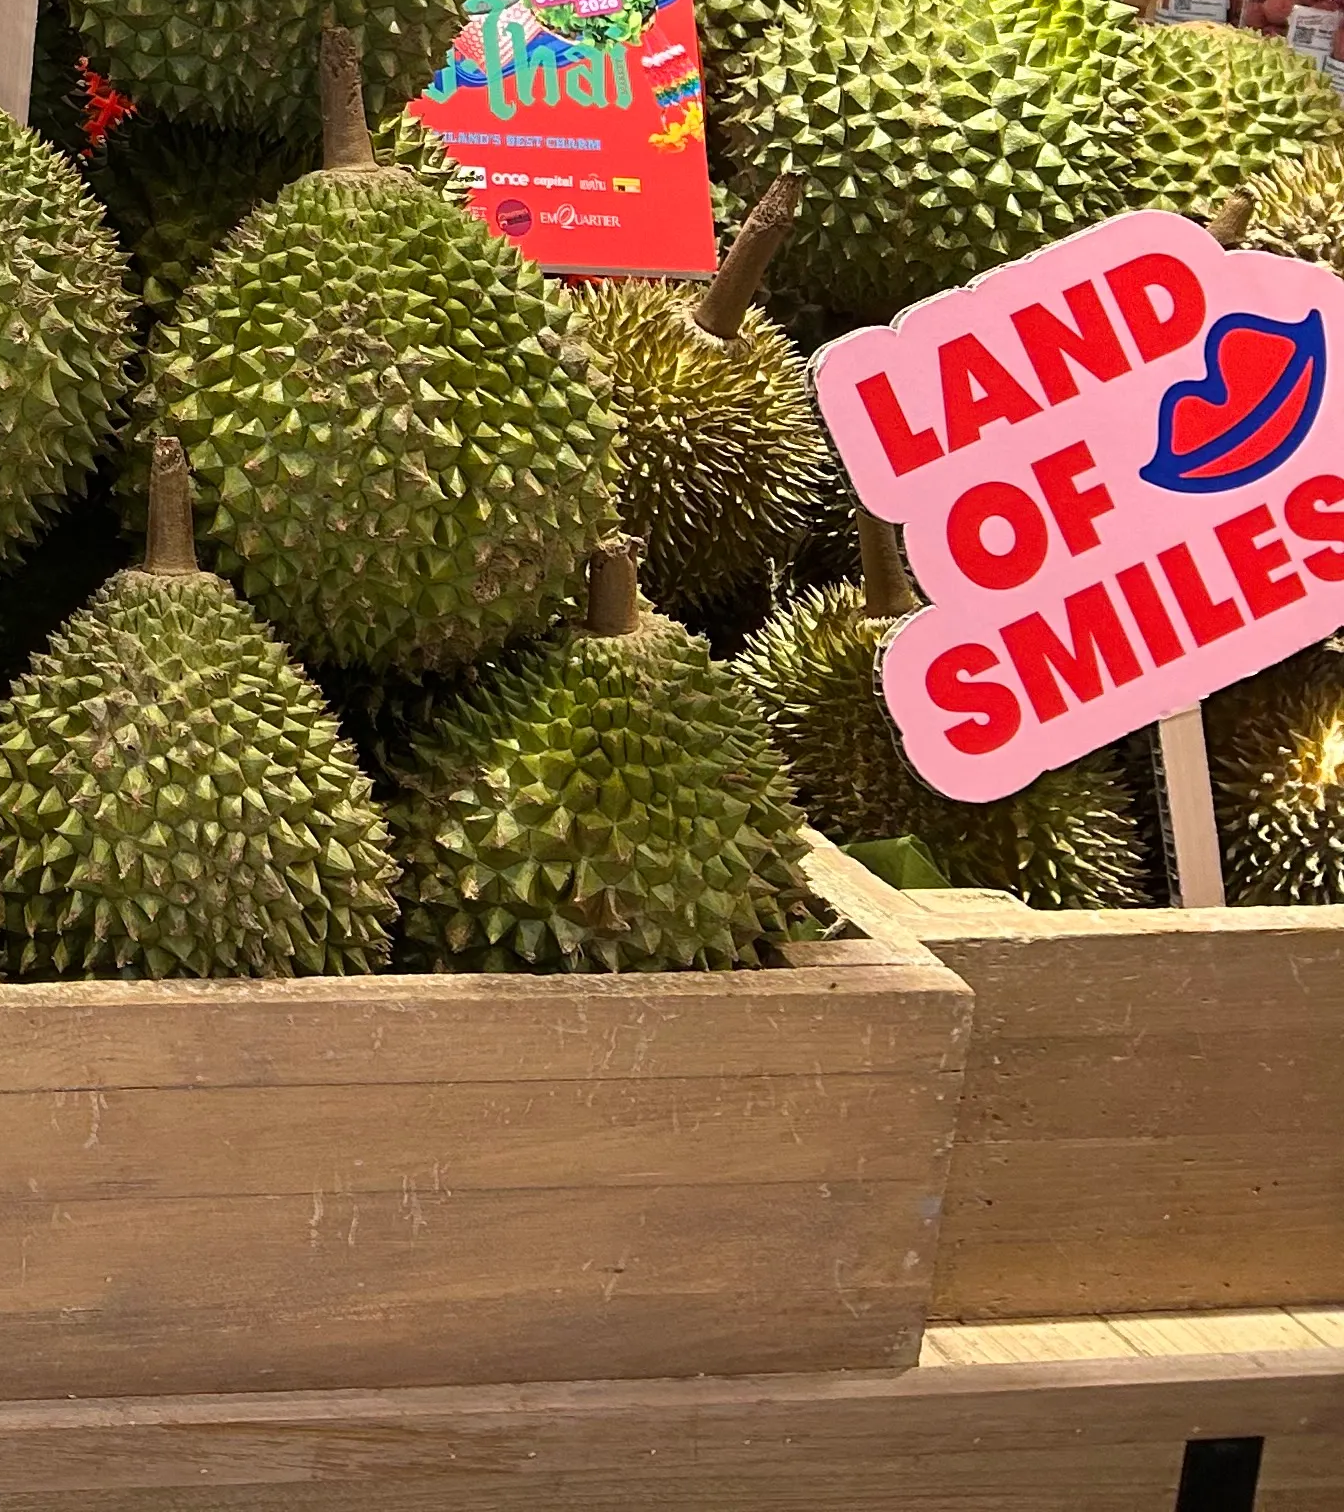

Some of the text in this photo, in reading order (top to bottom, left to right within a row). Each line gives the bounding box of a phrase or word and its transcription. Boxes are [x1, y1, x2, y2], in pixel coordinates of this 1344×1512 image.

[855, 253, 1206, 477] LAND
[925, 474, 1344, 755] SMILES
[947, 440, 1115, 590] OF
